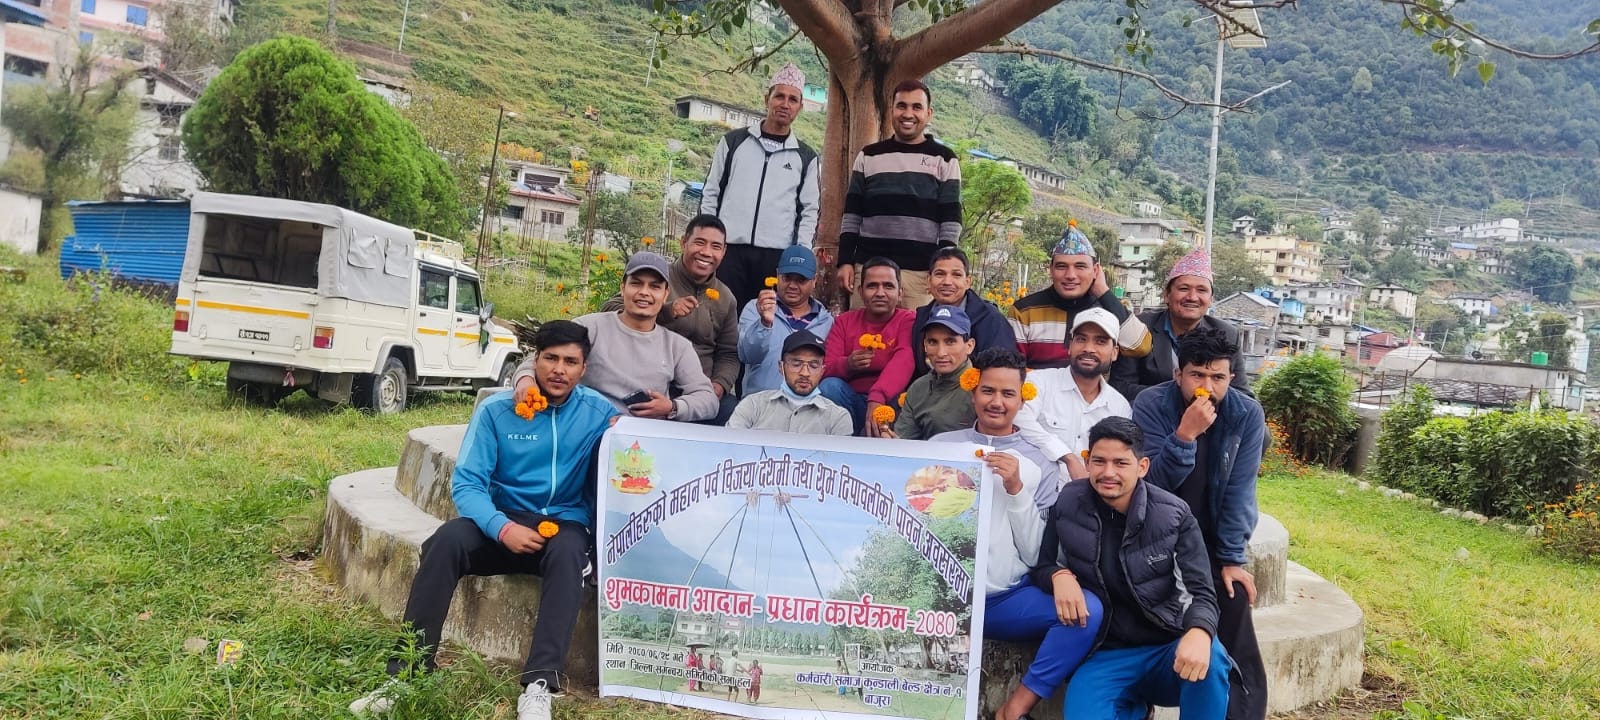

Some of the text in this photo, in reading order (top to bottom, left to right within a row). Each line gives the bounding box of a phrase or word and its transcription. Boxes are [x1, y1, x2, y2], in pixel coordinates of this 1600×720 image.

[507, 433, 538, 441] KELME
[669, 477, 702, 516] महान
[704, 463, 721, 499] पर्व
[721, 459, 757, 494] विजया
[758, 453, 791, 488] दशमी
[792, 459, 814, 490] तथा
[815, 463, 837, 502] शुभ
[838, 465, 894, 526] दिपावलीको
[895, 504, 924, 550] पावन
[922, 529, 971, 603] अवसरमा
[606, 578, 690, 609] शुभकामना
[767, 595, 822, 622] प्रधान
[606, 643, 624, 654] मिति
[672, 652, 684, 663] गते
[605, 659, 626, 669] स्थान
[630, 658, 653, 673] जिल्ला
[655, 664, 683, 677] समन्वय
[685, 668, 717, 683] समितीको
[860, 661, 894, 673] आयोजक
[796, 671, 832, 685] कर्मचारी
[834, 676, 861, 687] समाज
[924, 681, 941, 695] क्षेत्र
[864, 694, 891, 707] बाजुरा
